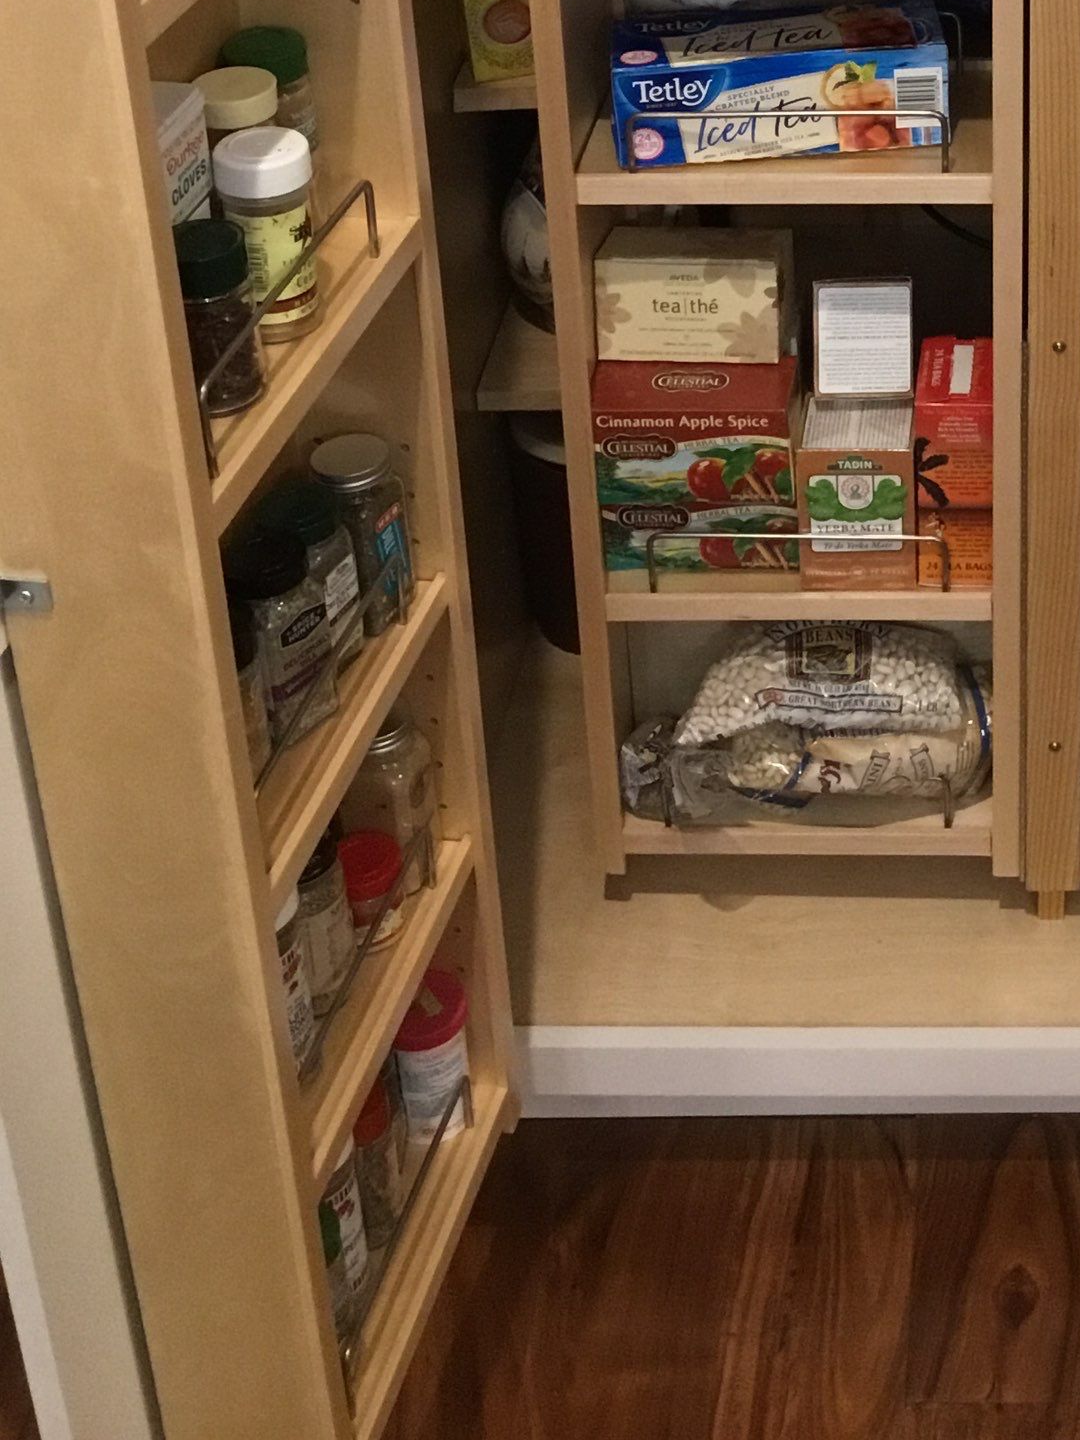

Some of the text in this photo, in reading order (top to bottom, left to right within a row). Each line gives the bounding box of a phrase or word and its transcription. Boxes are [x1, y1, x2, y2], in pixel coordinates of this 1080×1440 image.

[631, 77, 713, 107] Tetley
[727, 85, 775, 101] SPECIALLY
[760, 90, 790, 103] BLEND
[693, 100, 762, 154] Iced
[171, 158, 207, 207] CLOVES
[652, 297, 719, 314] tea thé
[657, 375, 721, 387] CELESTIAL
[596, 414, 769, 431] Cinnamon Apple Spice
[606, 440, 670, 455] CELESTIAL
[837, 460, 873, 470] TADIN
[622, 510, 685, 525] CELESTIAL
[860, 522, 896, 533] MATE
[805, 629, 852, 644] BEANS
